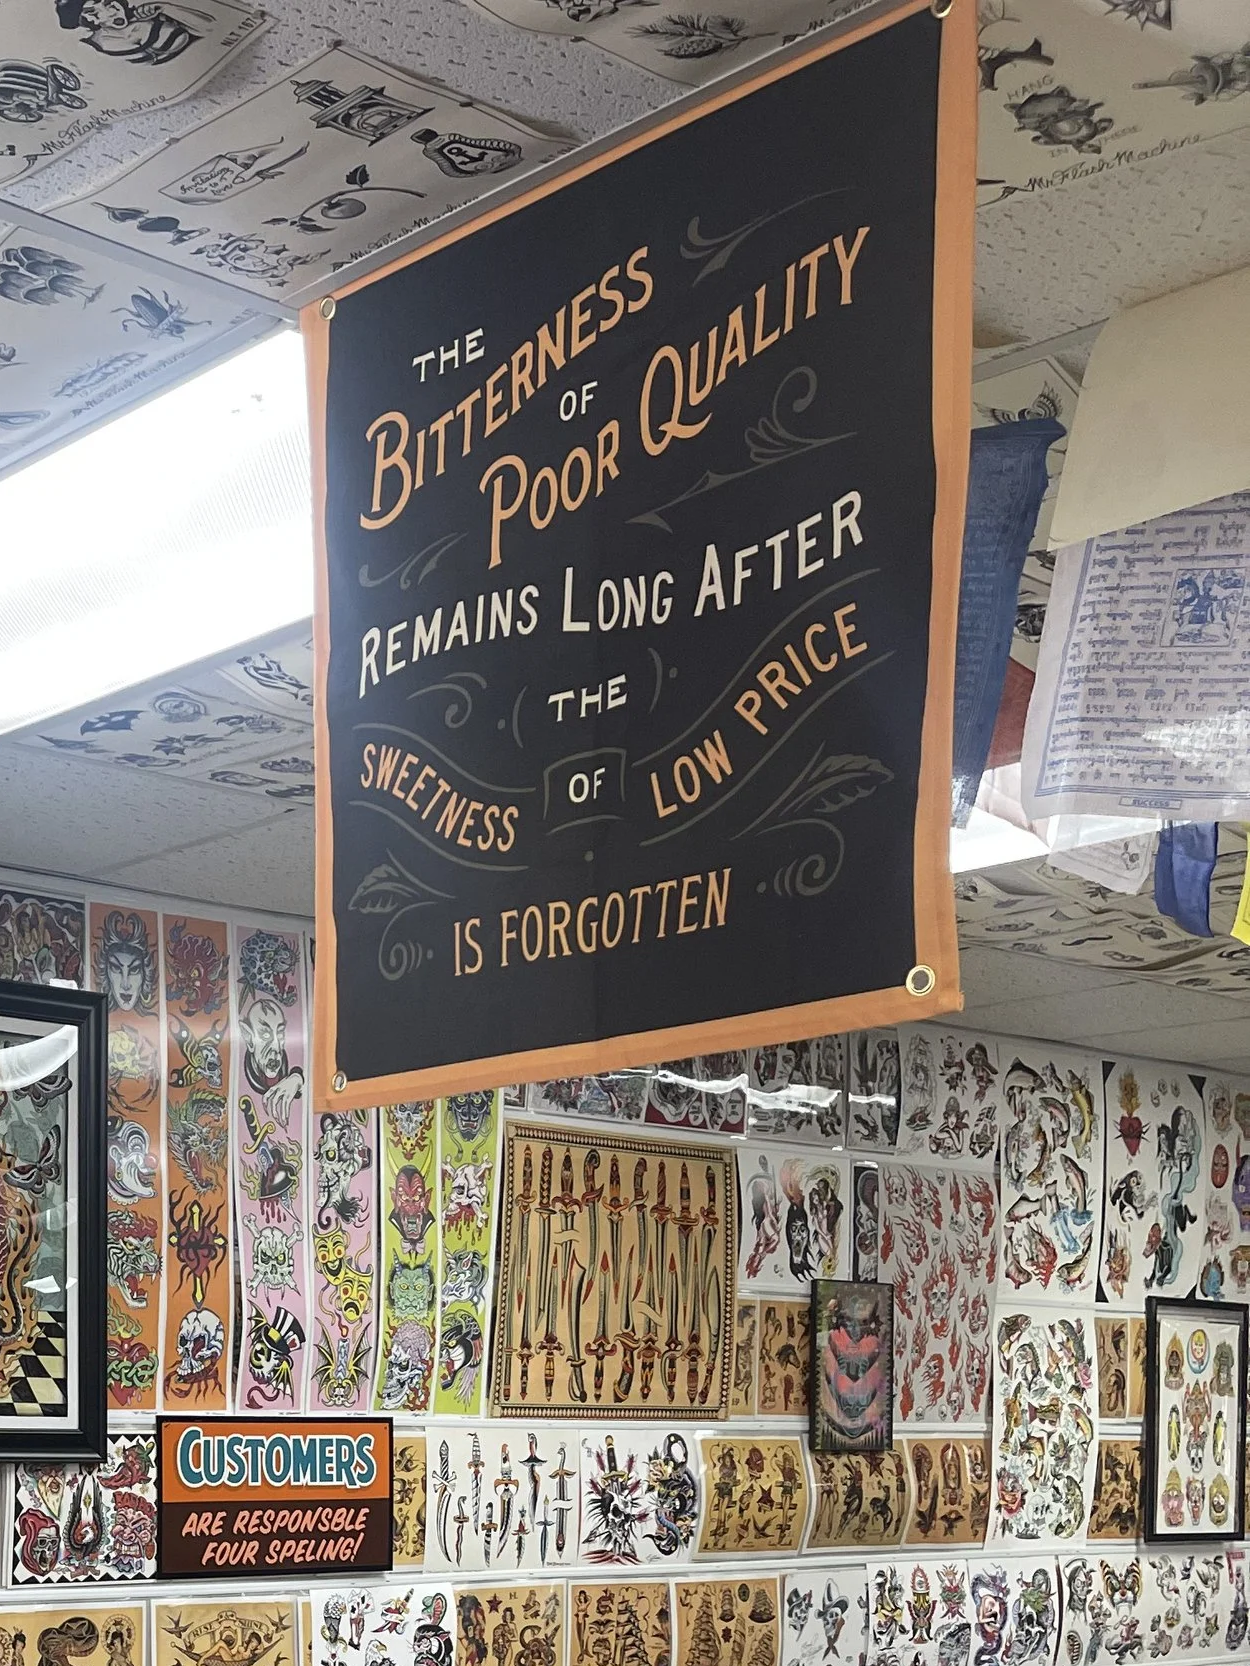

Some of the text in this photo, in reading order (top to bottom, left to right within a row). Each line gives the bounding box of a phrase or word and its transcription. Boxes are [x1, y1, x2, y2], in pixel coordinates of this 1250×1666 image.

[360, 246, 655, 531] BITTERNESS
[413, 328, 485, 385] THE
[479, 226, 872, 569] POOR QUALITY
[560, 380, 599, 421] OF
[358, 490, 866, 700] REMAINS LONG AFTER
[359, 602, 869, 854] SWEETNESS OF LOW PRICE
[548, 674, 628, 722] THE
[453, 867, 732, 977] IS FORGOTTEN
[177, 1425, 377, 1489] CUSTOMERS
[181, 1506, 370, 1538] ARE RESPONSBLE
[201, 1532, 365, 1566] FOUR SPELING!
